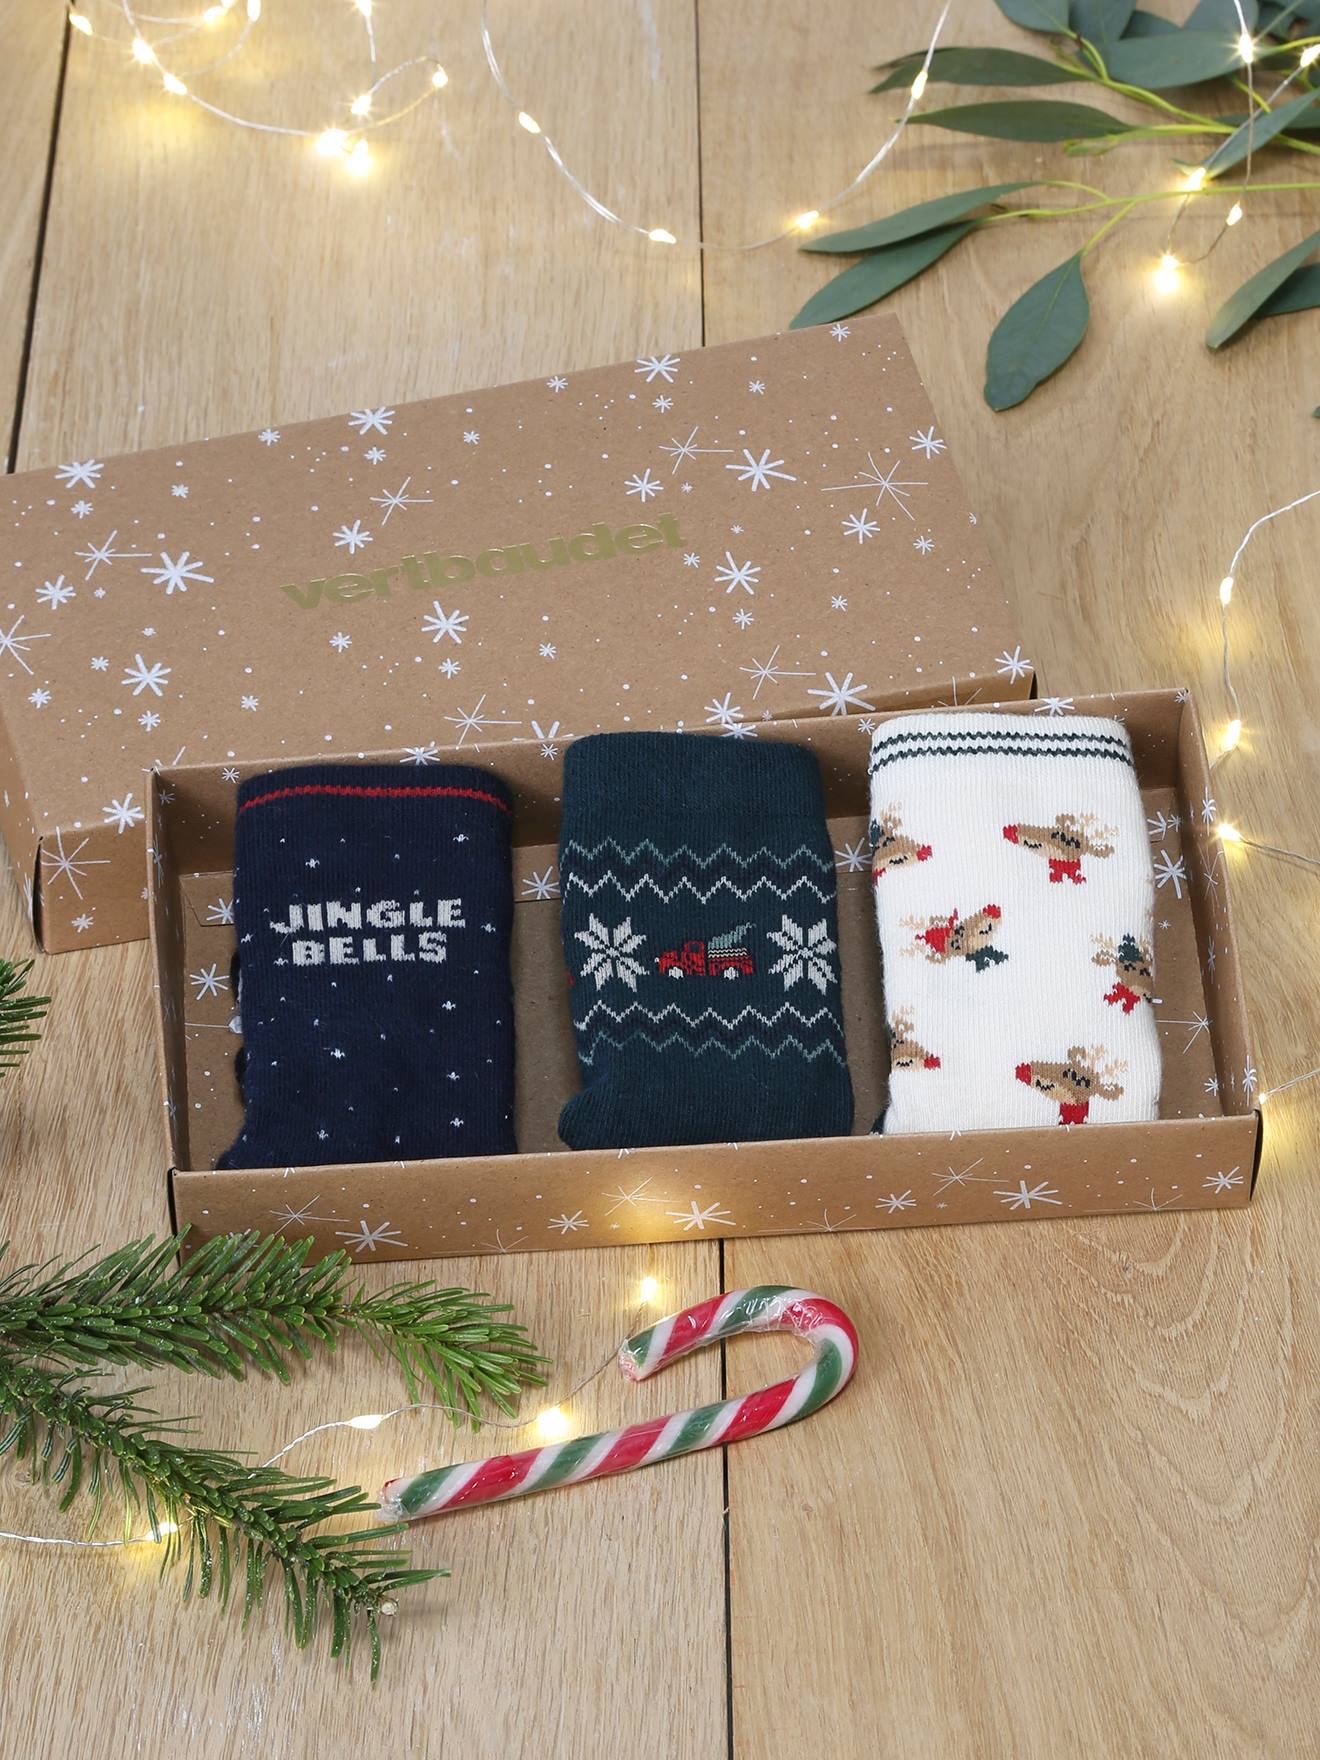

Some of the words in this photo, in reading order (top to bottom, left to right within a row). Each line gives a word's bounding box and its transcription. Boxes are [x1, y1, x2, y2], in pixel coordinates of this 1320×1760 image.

[280, 512, 688, 609] vertbaudet
[269, 898, 466, 934] JINGLE
[292, 930, 447, 966] BELLS
